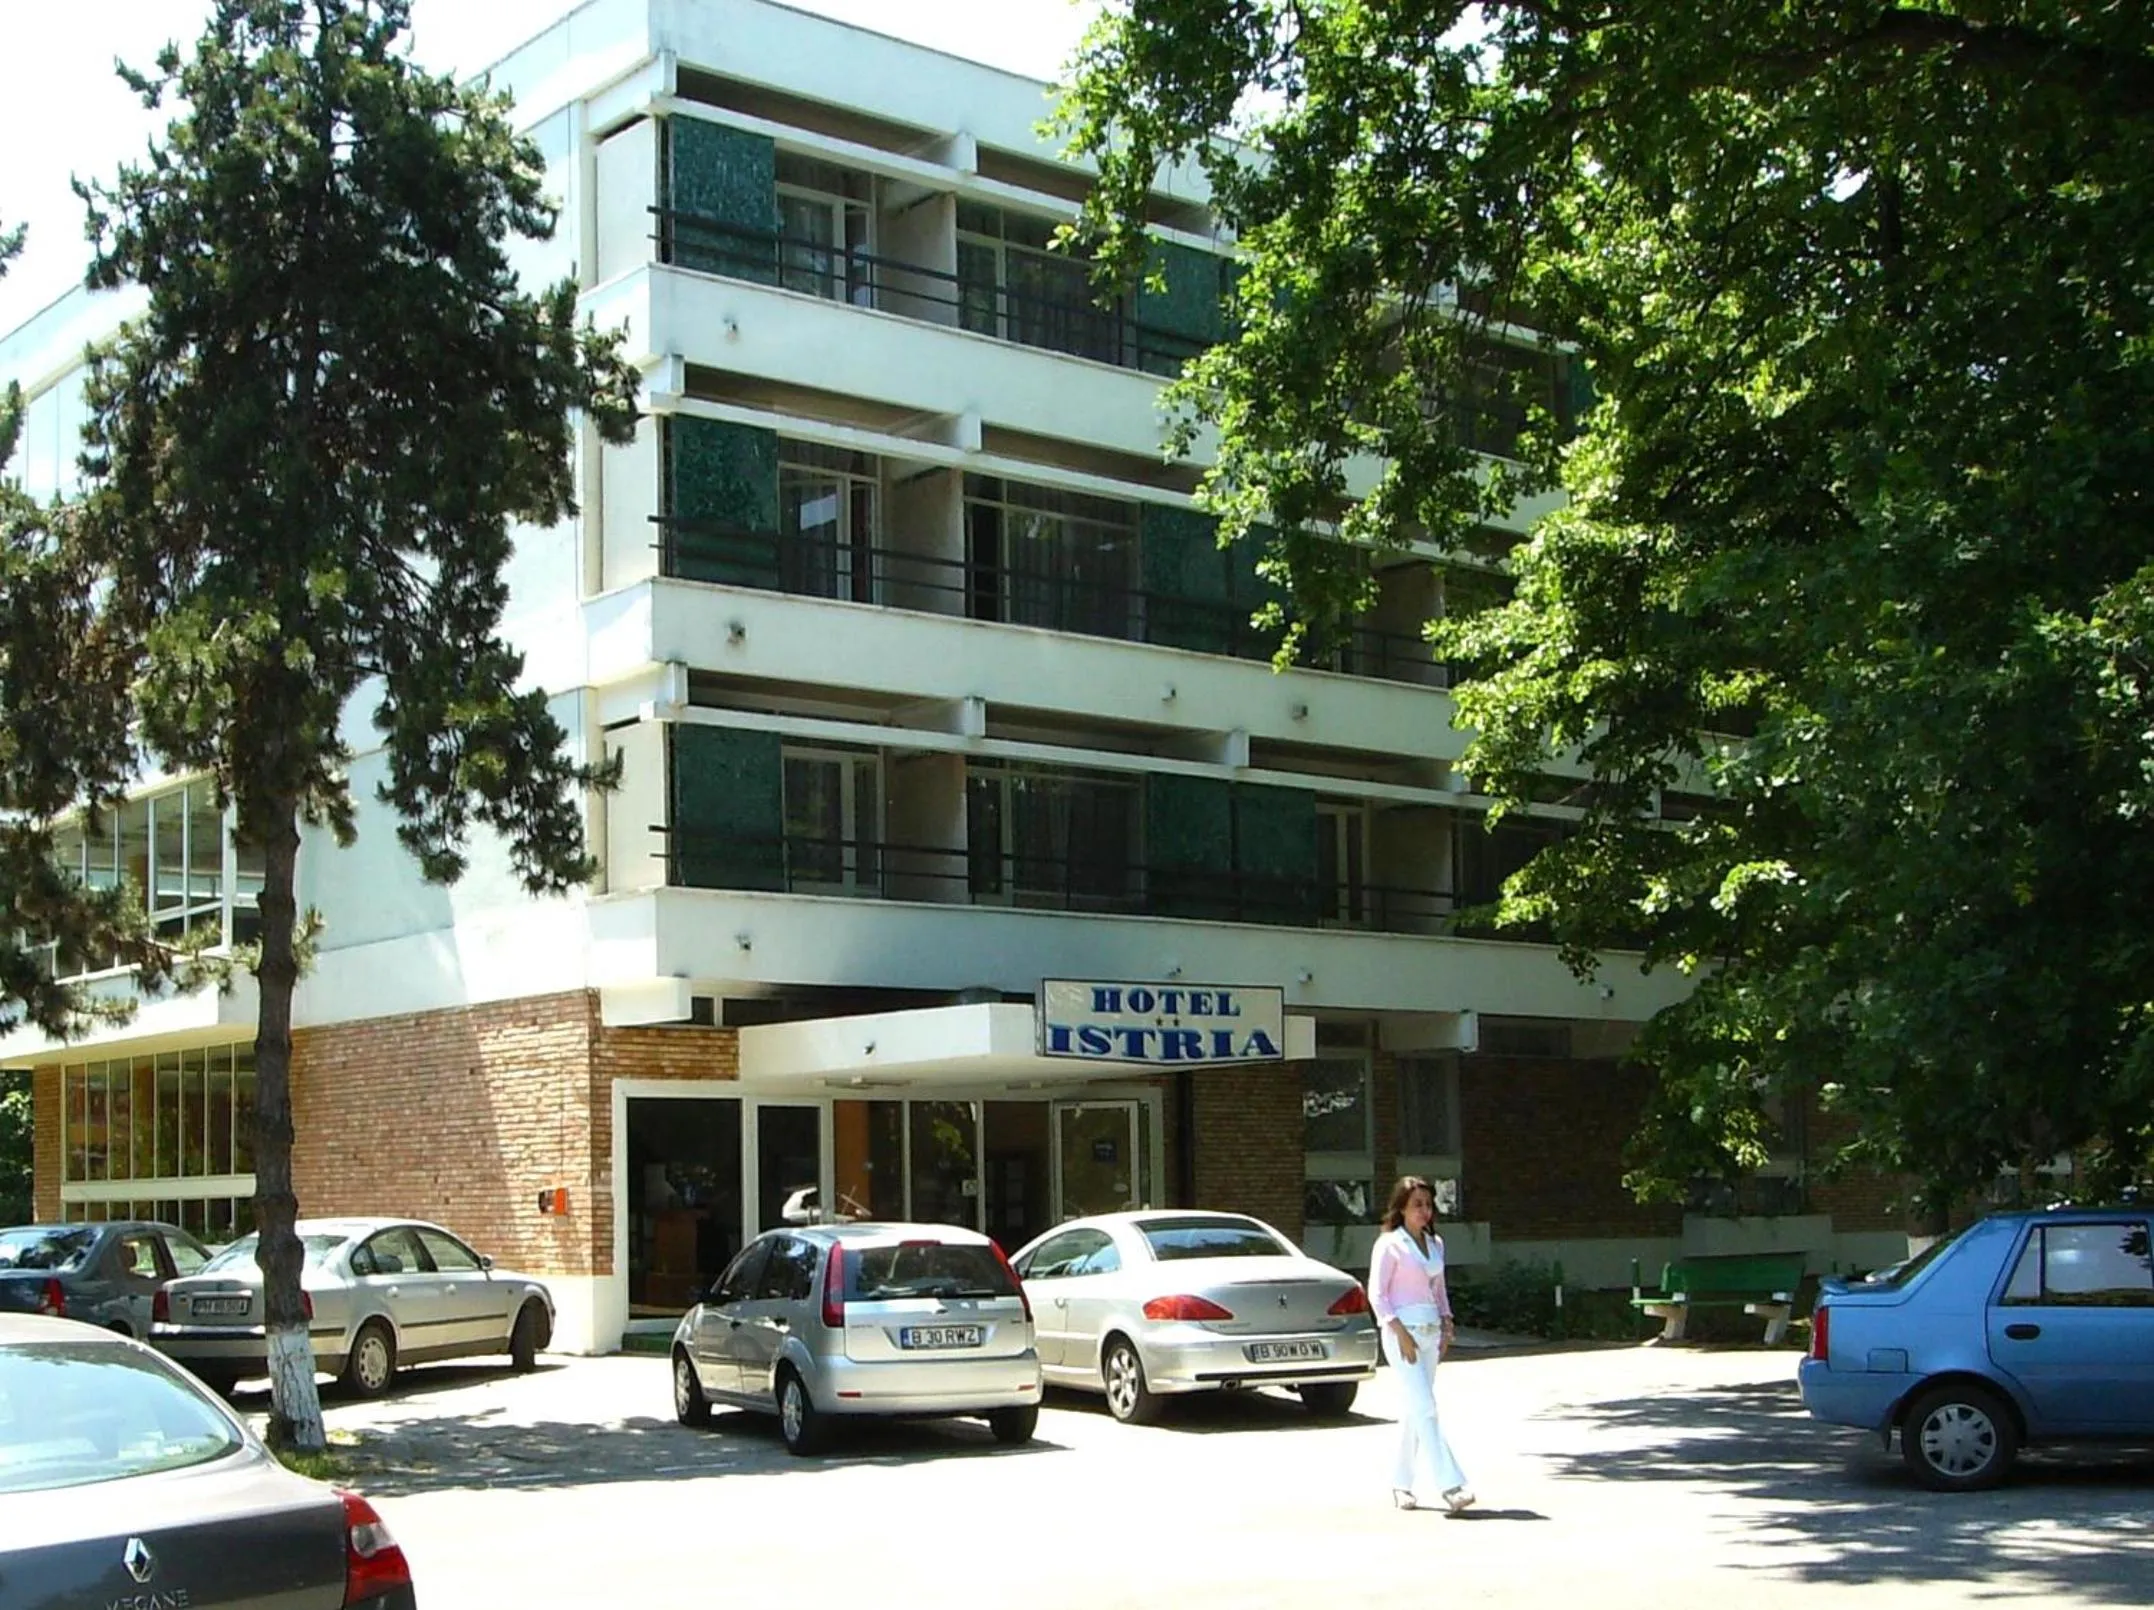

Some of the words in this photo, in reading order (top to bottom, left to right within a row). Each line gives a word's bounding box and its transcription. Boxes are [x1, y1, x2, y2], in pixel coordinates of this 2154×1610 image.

[1092, 986, 1240, 1017] HOTEL
[1048, 1023, 1280, 1060] ISTRIA
[911, 1330, 922, 1344] B
[926, 1330, 942, 1344] 30
[945, 1328, 976, 1344] RWZ
[1260, 1344, 1270, 1358] B
